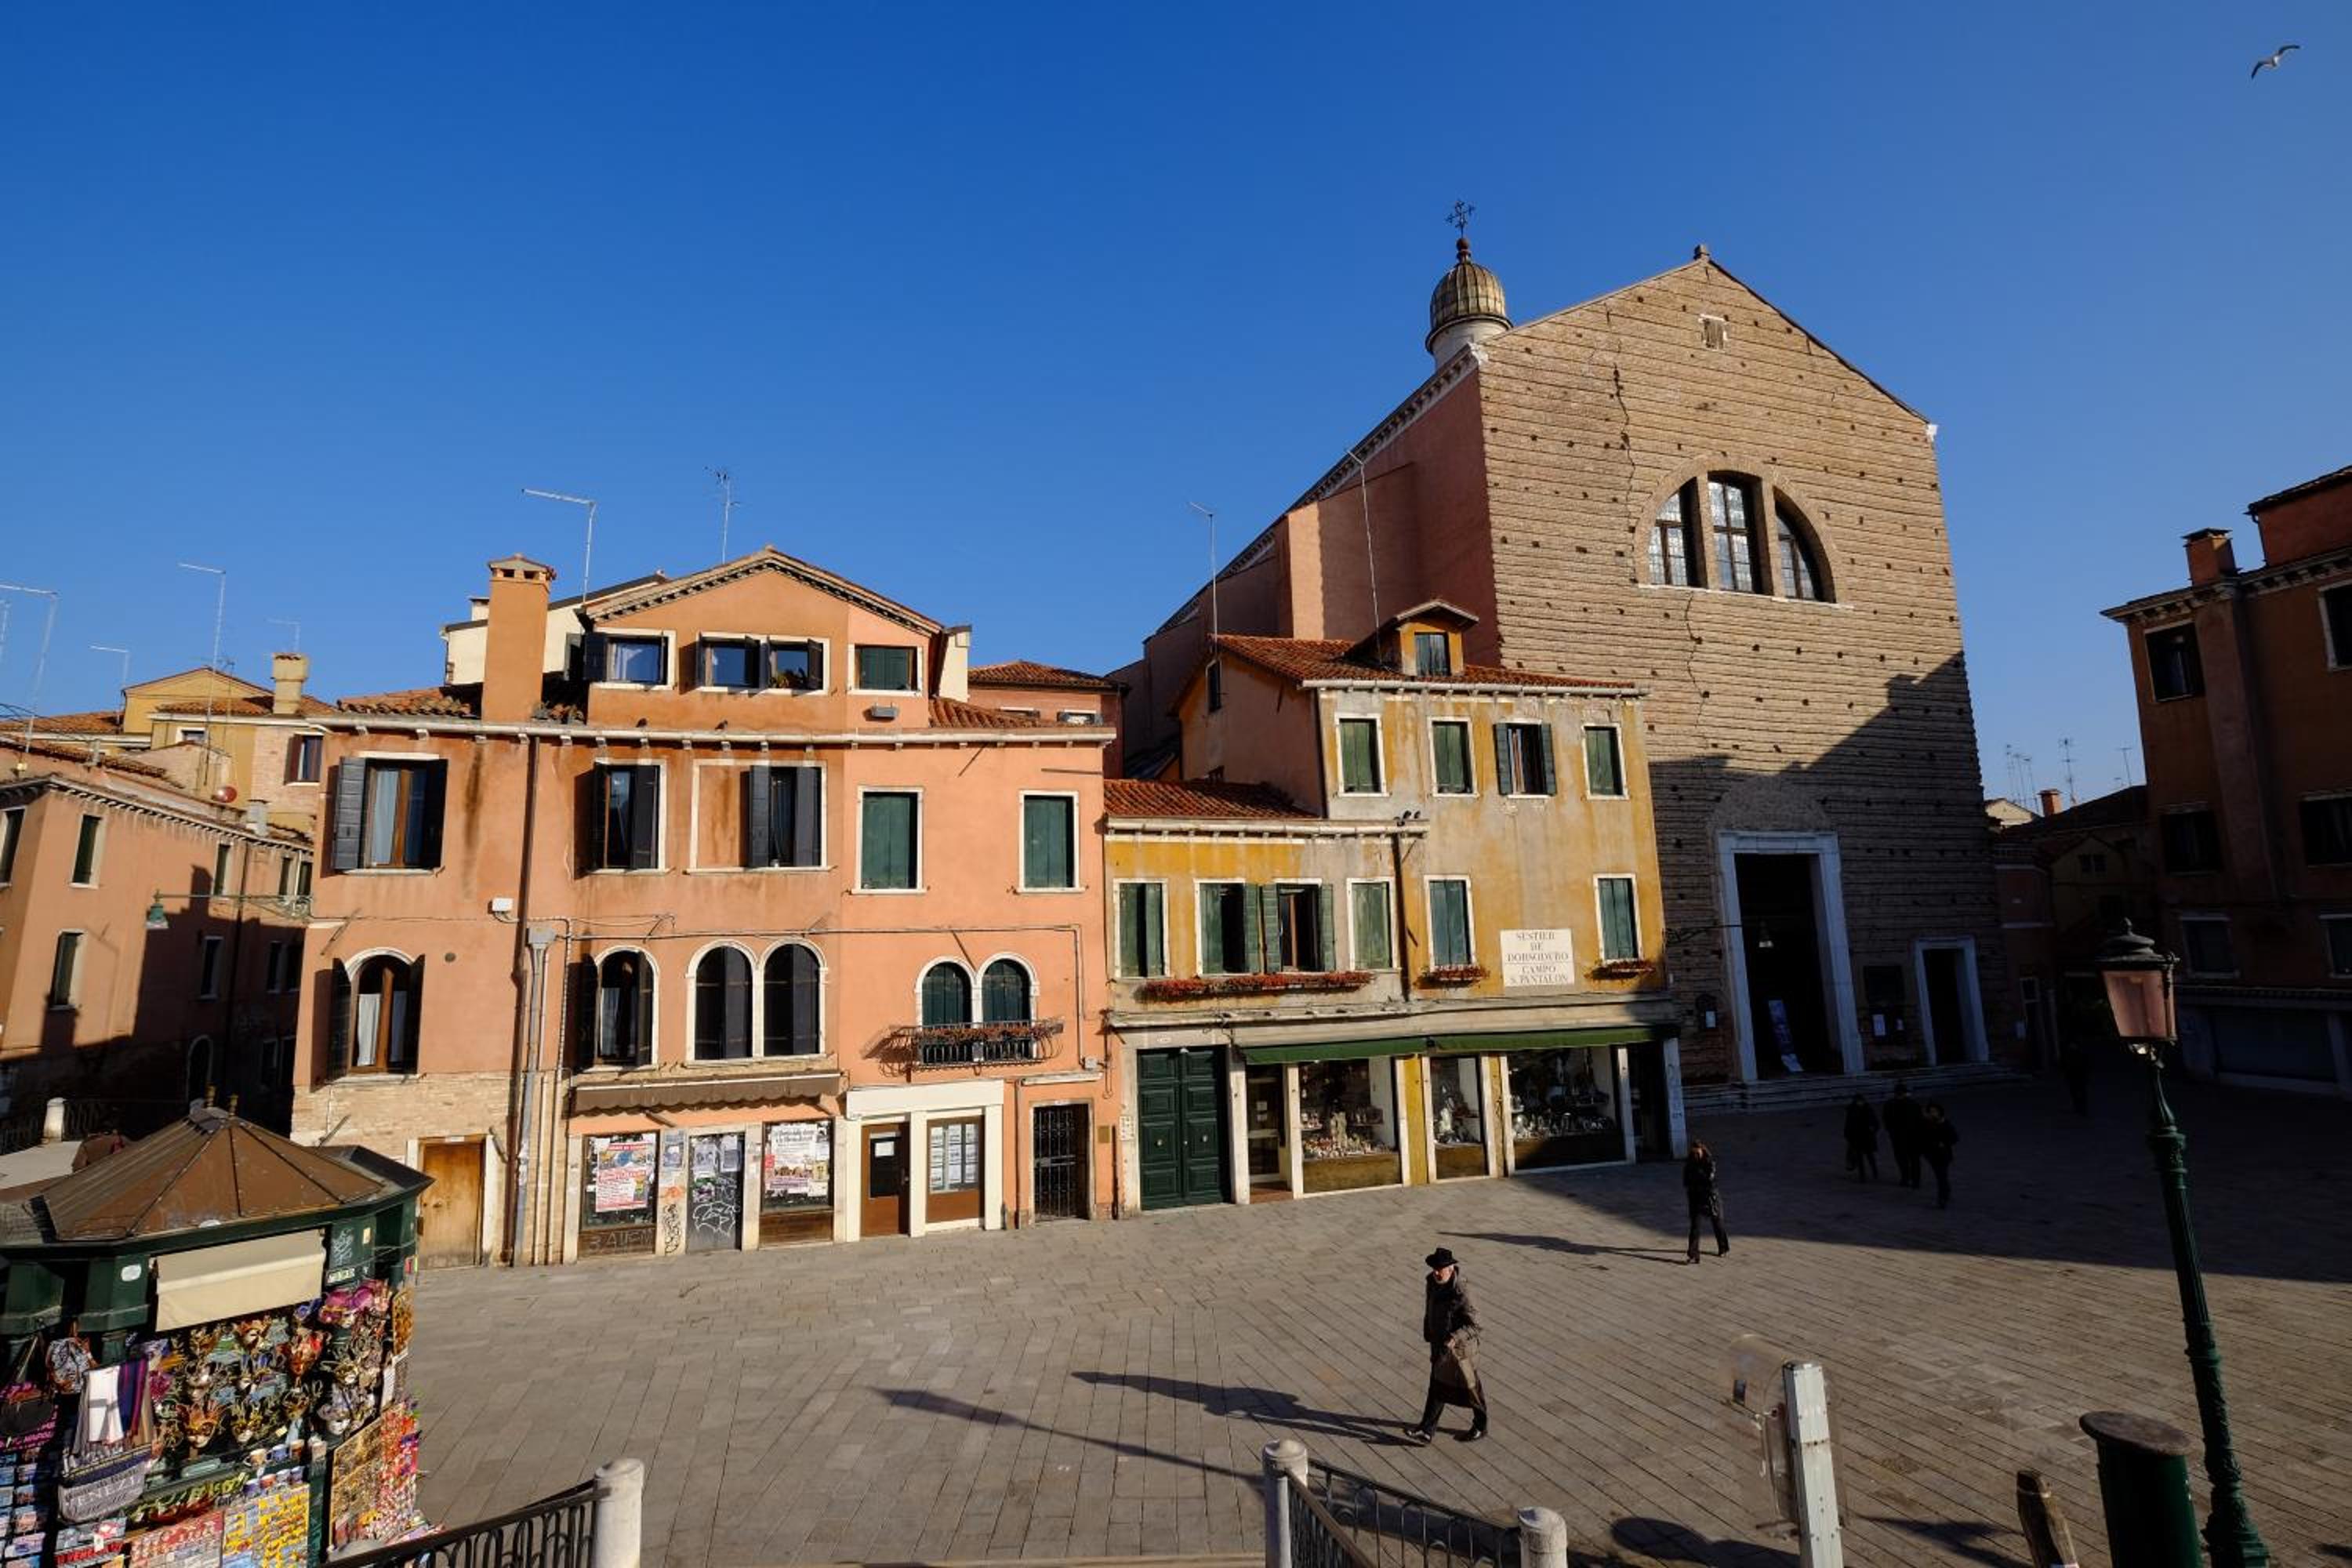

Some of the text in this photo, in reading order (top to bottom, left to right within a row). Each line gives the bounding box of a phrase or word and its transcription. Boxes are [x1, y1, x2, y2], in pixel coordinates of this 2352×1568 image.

[1516, 931, 1555, 941] SESTIER
[1530, 942, 1543, 952] DE
[1520, 965, 1556, 974] CAMPO
[1519, 975, 1568, 984] PANTALON
